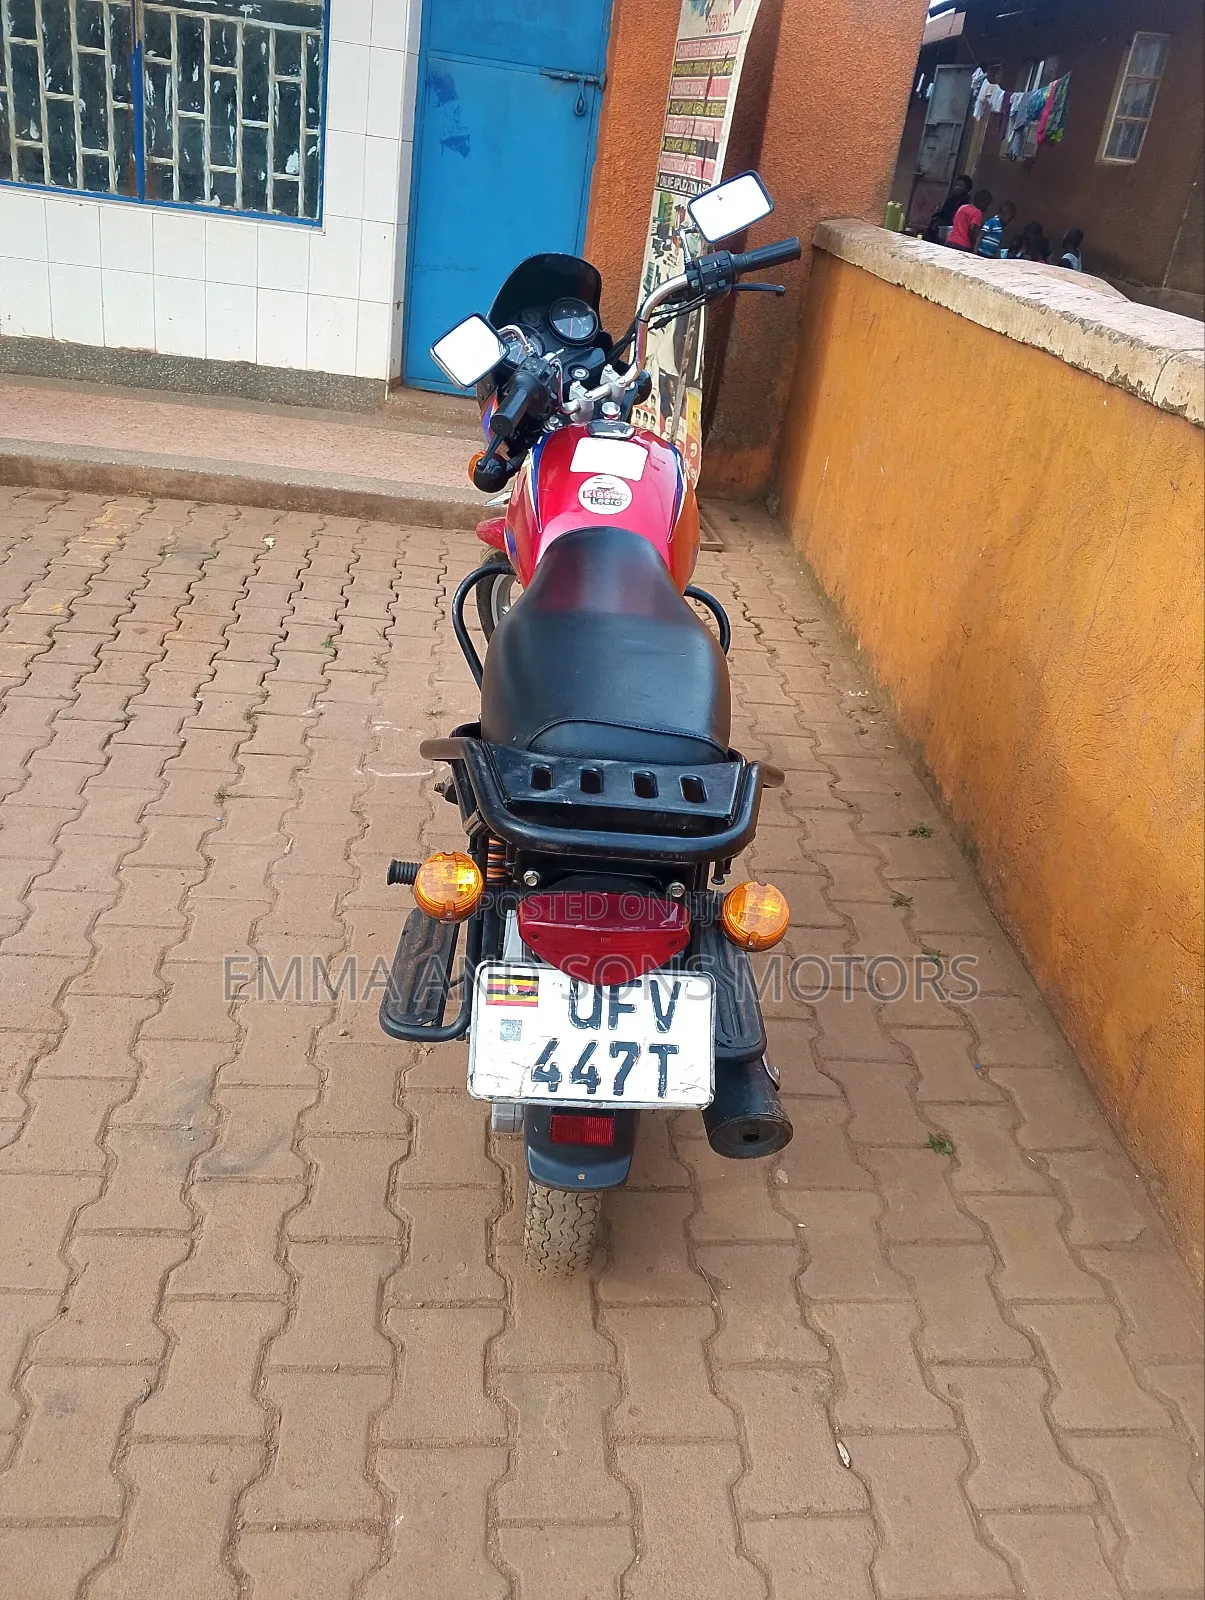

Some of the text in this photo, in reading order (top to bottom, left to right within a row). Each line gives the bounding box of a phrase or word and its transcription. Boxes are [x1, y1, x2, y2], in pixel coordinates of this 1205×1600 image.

[706, 12, 731, 33] SERVICES
[568, 979, 682, 1033] UFV
[531, 1037, 680, 1099] 447T
